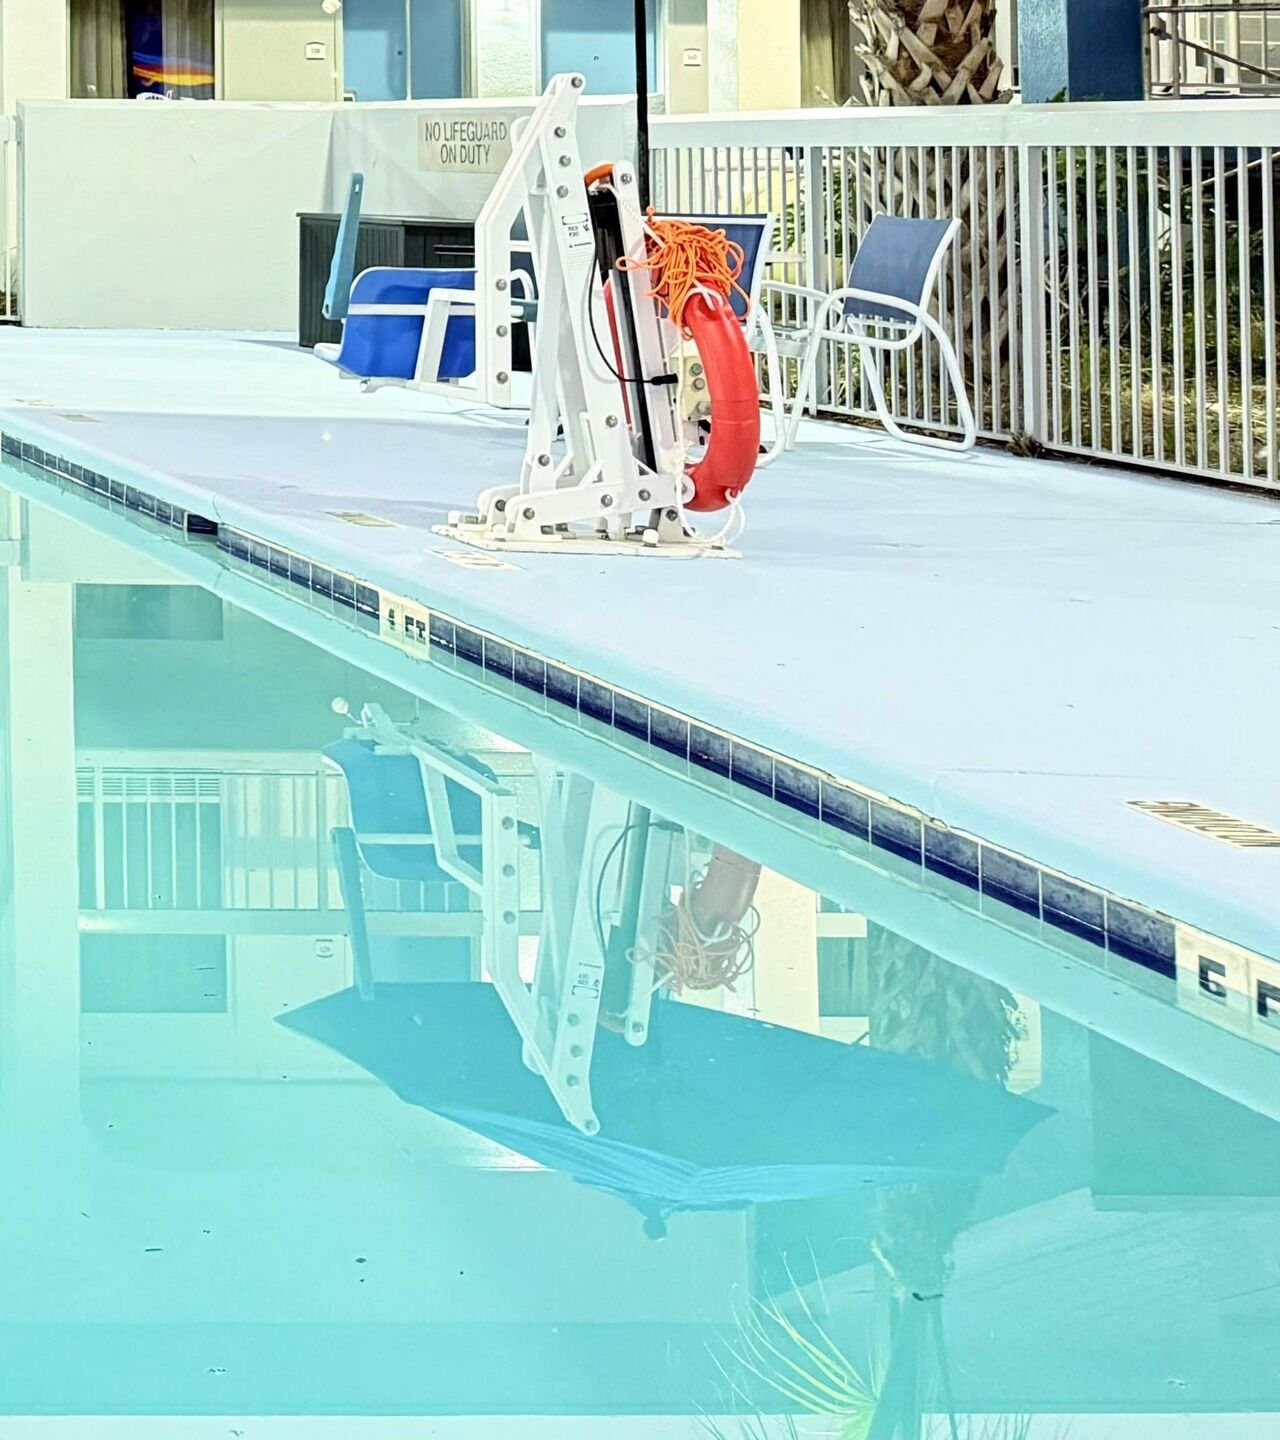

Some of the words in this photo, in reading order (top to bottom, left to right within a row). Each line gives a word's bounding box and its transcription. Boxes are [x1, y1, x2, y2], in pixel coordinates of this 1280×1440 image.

[425, 122, 440, 142] NO
[443, 121, 507, 142] LIFEGUARD
[440, 144, 456, 164] ON
[460, 144, 490, 165] DUTY
